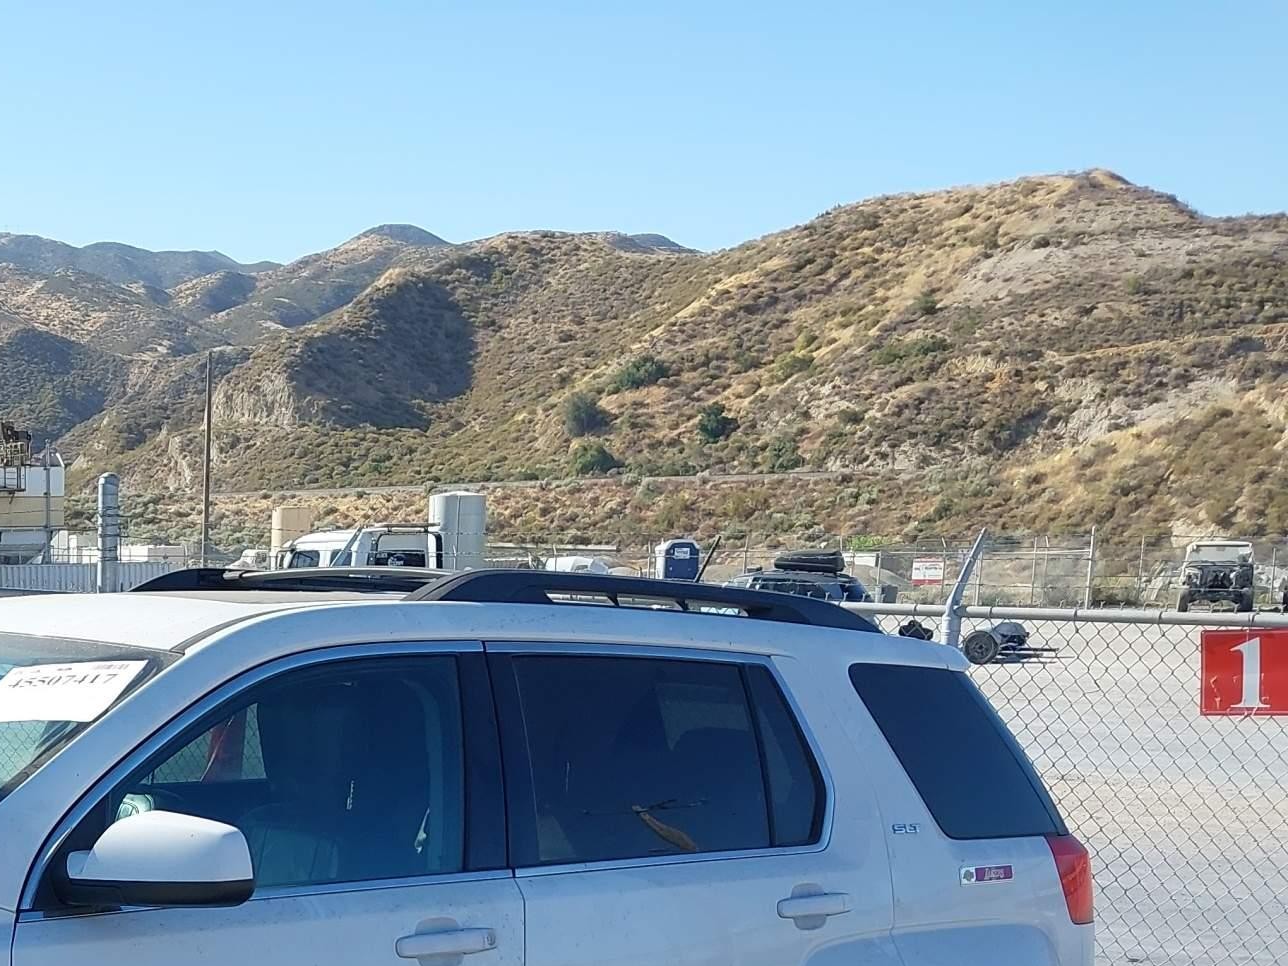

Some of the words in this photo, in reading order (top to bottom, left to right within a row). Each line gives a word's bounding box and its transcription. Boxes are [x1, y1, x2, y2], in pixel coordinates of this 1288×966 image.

[1229, 636, 1272, 708] 1
[7, 673, 119, 689] 45507417
[892, 823, 921, 835] SLT
